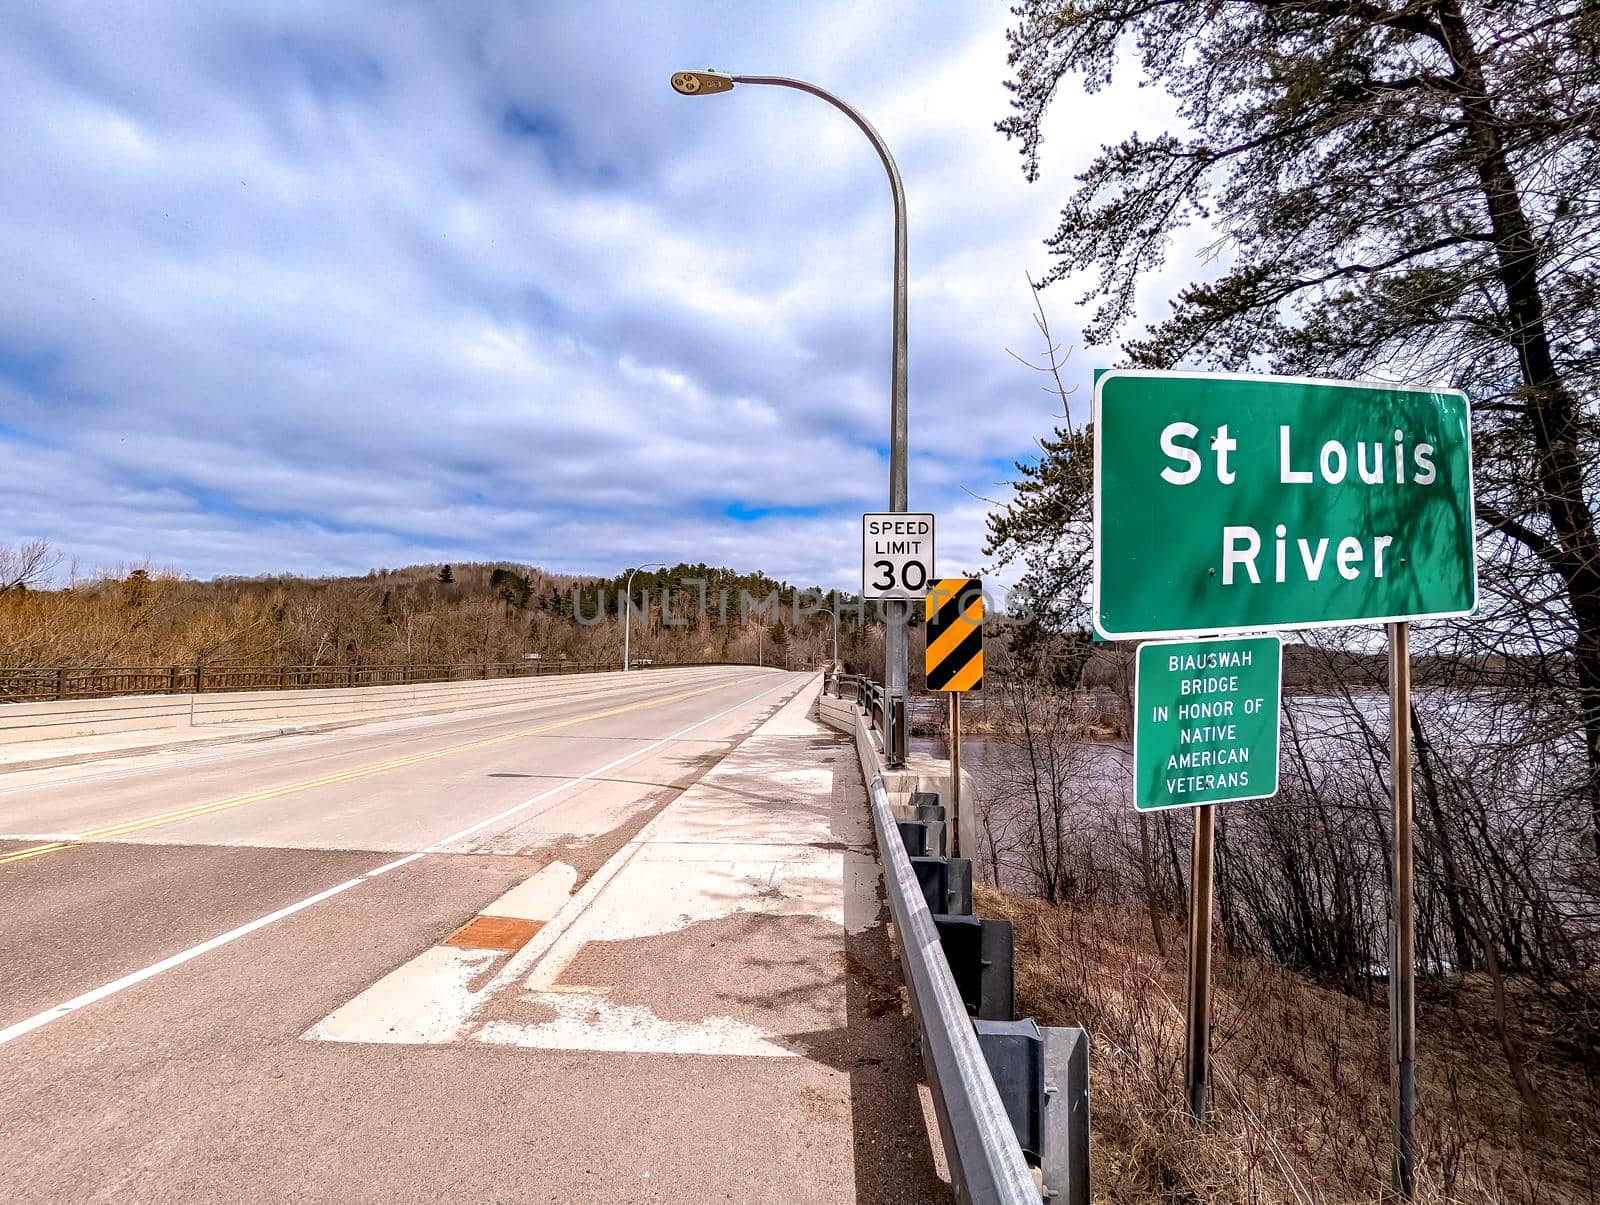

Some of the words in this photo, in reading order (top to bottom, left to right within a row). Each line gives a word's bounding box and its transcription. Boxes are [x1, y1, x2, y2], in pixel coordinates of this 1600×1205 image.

[1160, 422, 1237, 485] St
[1280, 426, 1436, 485] Louis
[869, 521, 929, 535] SPEED
[875, 541, 922, 555] LIMIT
[1222, 525, 1393, 585] River
[871, 560, 927, 591] 30
[1168, 650, 1252, 672] BIAUSWAH
[1181, 676, 1239, 696] BRIDGE
[1153, 706, 1169, 723] IN
[1178, 701, 1234, 721] HONOR
[1244, 698, 1265, 715] OF
[1180, 725, 1236, 745] NATIVE
[1167, 747, 1249, 770] AMERICAN
[1166, 771, 1249, 794] VETERANS
